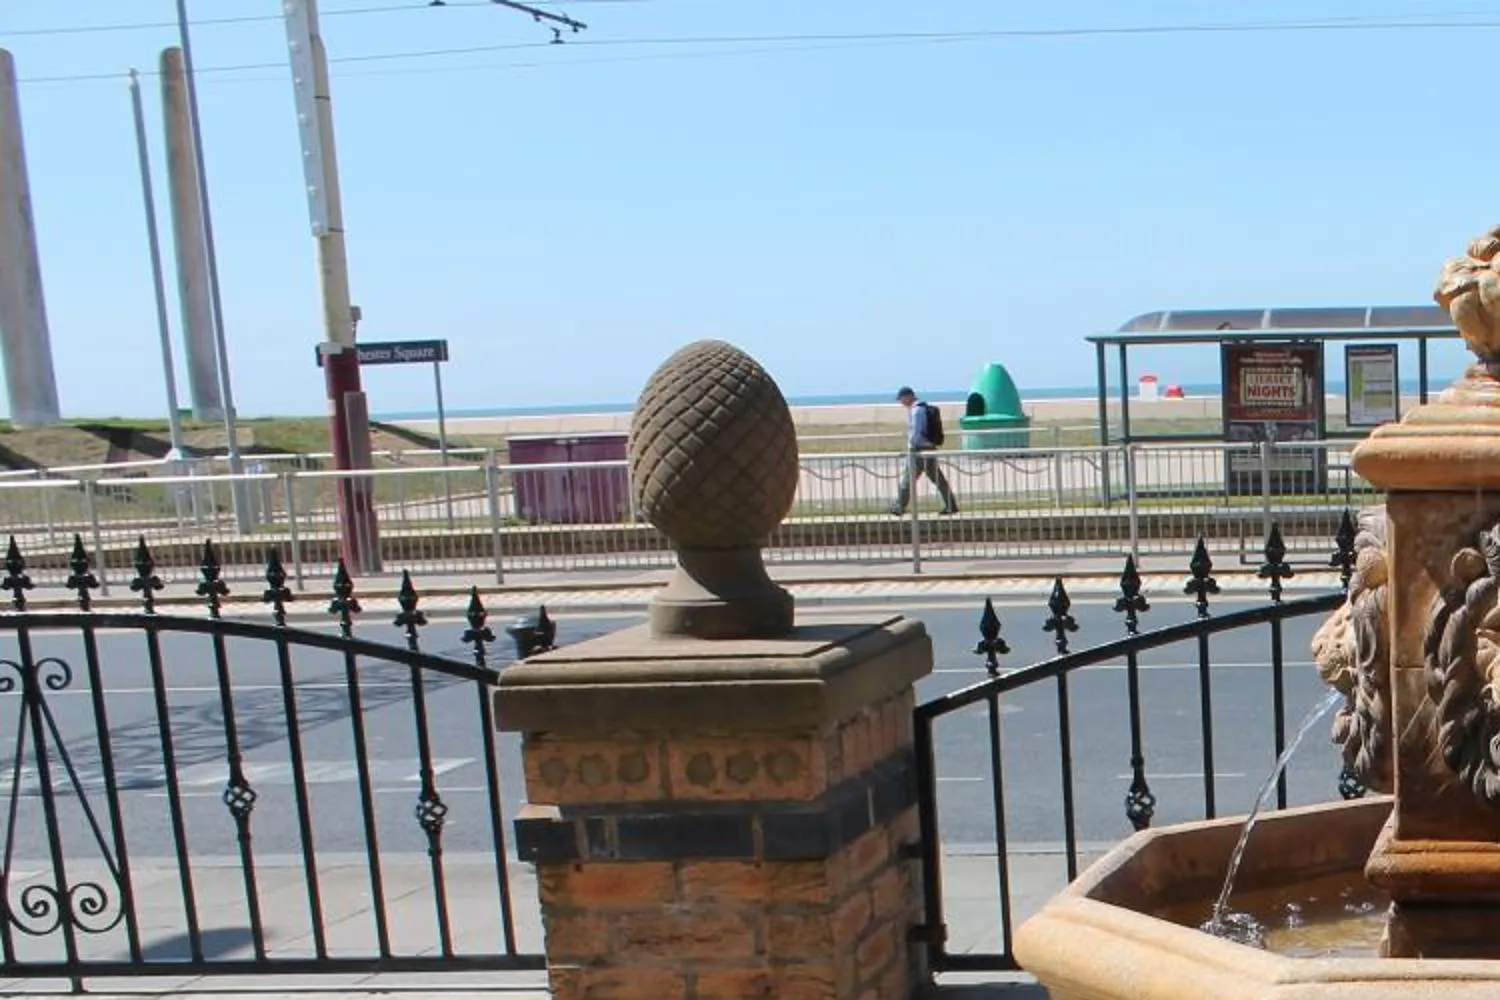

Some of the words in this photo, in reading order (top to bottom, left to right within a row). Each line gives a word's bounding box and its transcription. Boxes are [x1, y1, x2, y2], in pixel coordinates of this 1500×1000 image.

[357, 349, 391, 360] hester
[393, 346, 435, 360] Square
[1247, 385, 1296, 398] NIGHTS
